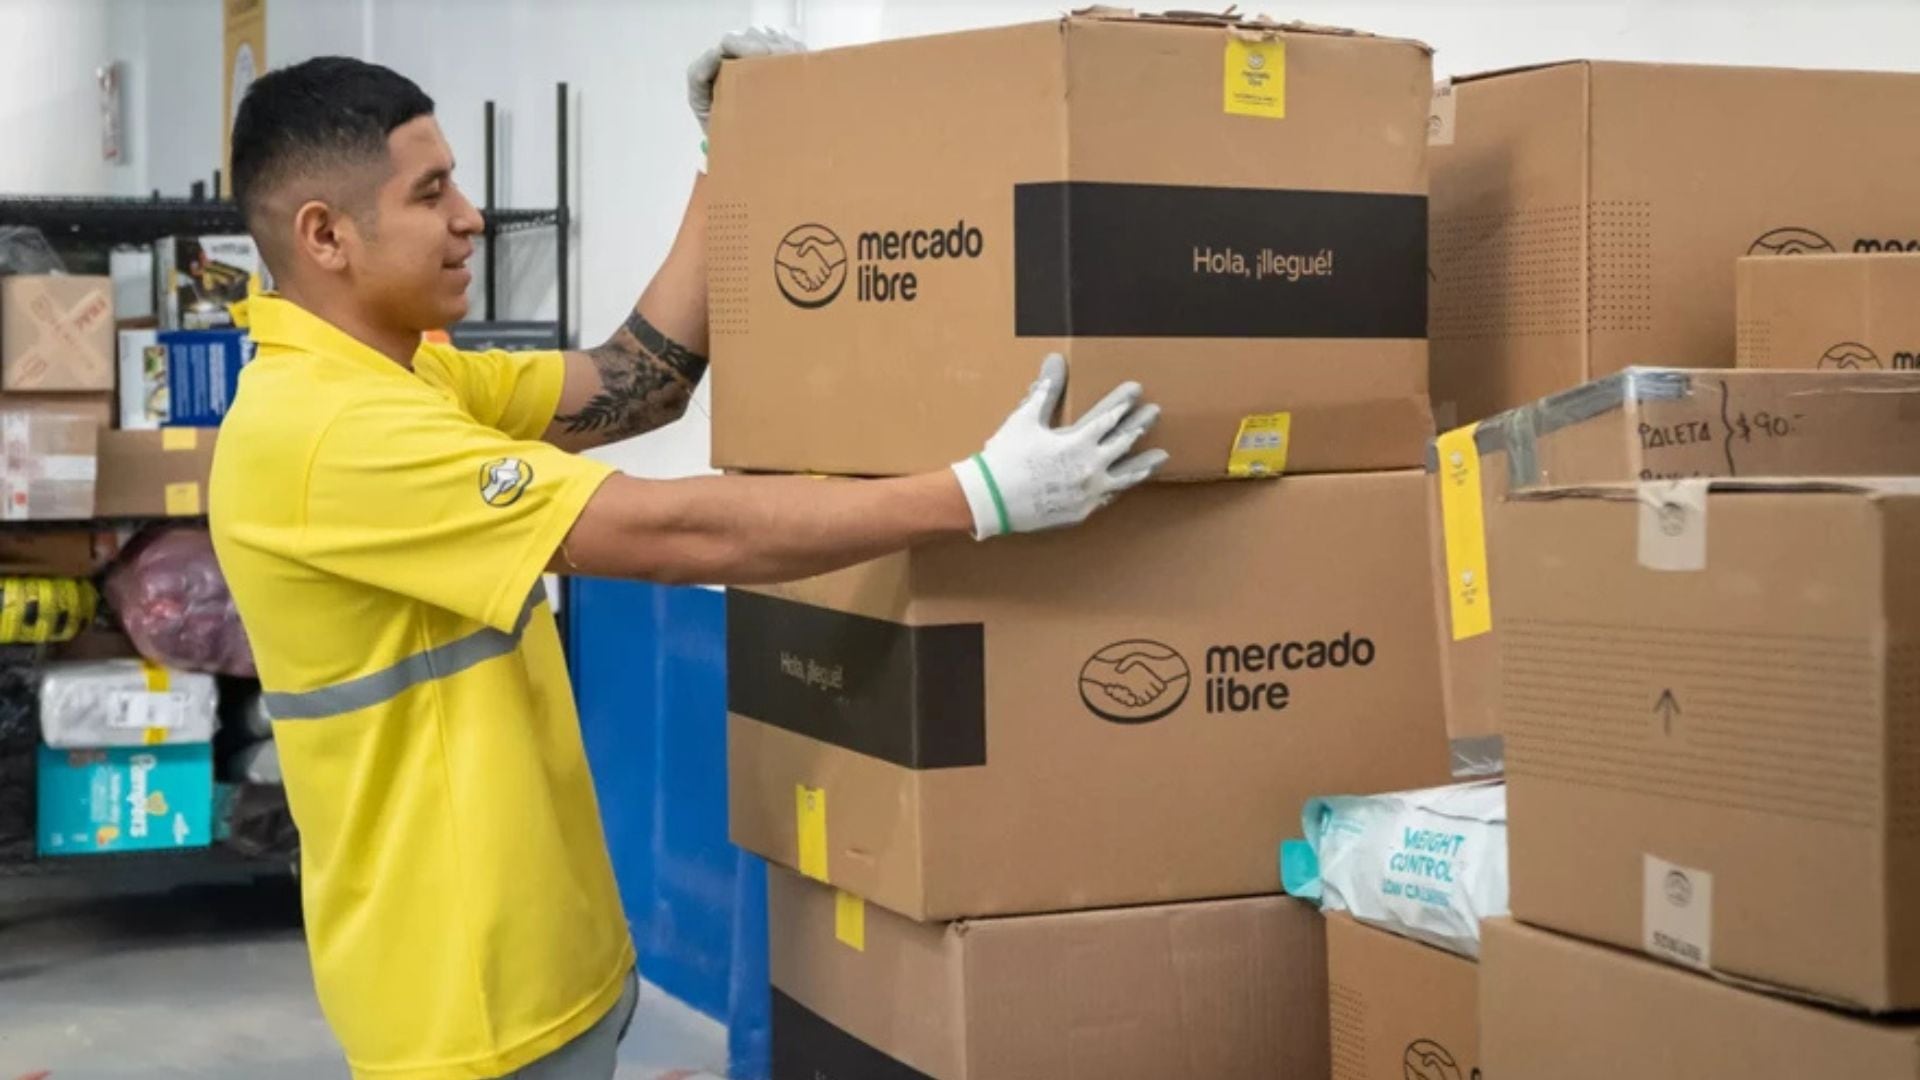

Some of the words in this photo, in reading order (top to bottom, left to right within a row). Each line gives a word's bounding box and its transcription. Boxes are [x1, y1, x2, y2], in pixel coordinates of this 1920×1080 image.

[858, 219, 983, 260] mercado
[1193, 246, 1250, 277] Hola,
[1256, 247, 1333, 281] ¡llegué!
[858, 264, 917, 302] libre
[1638, 421, 1711, 449] PALETA
[1206, 631, 1375, 674] mercado
[1206, 677, 1290, 713] libre
[125, 753, 157, 838] Pampers
[1404, 826, 1465, 857] WEIGHT
[1390, 853, 1453, 882] CONTROL
